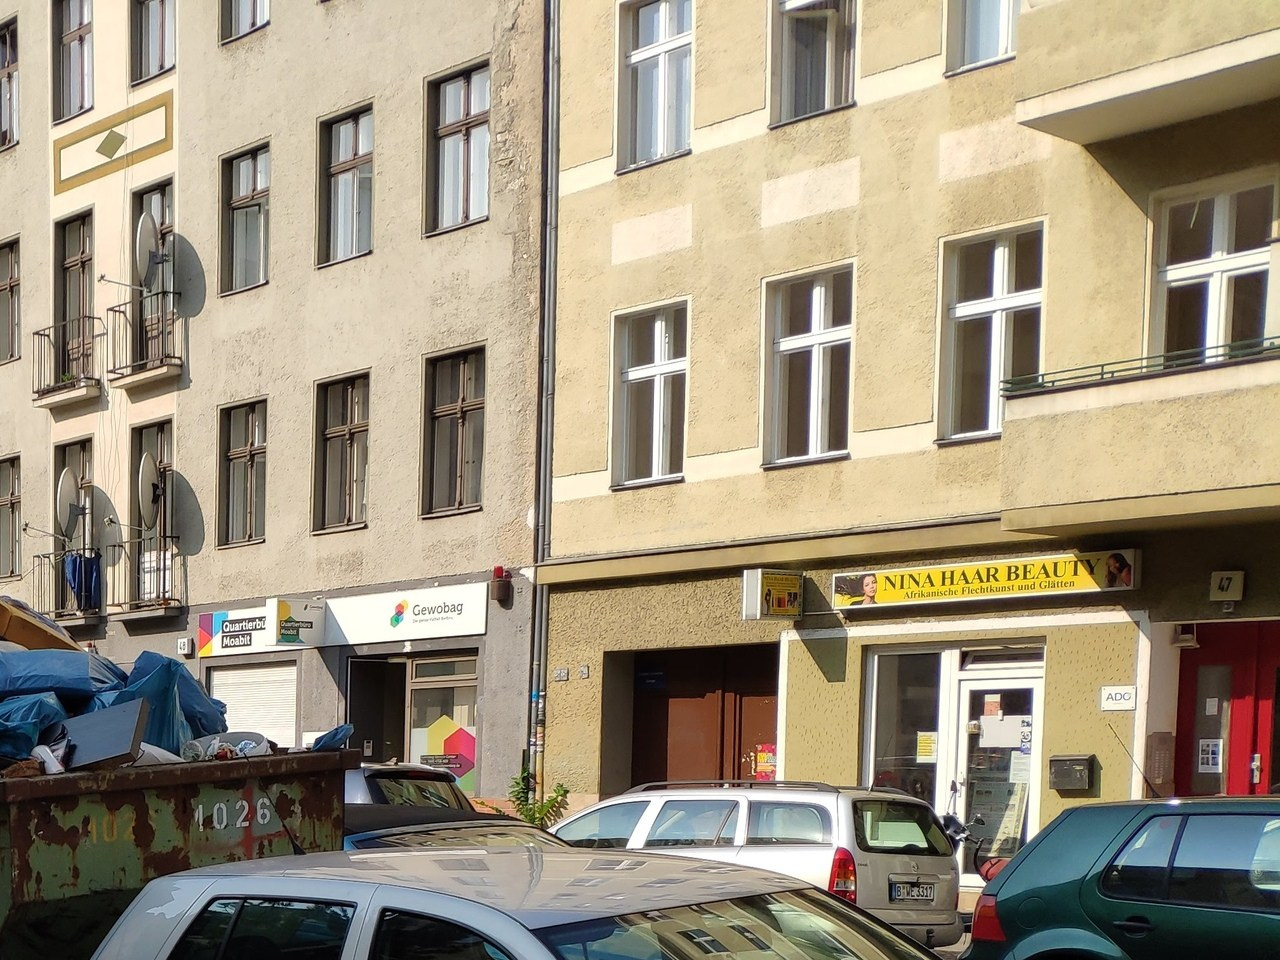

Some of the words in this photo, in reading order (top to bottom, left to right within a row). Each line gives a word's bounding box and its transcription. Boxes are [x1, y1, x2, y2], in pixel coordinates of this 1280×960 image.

[883, 572, 936, 591] NINA
[940, 566, 1000, 587] HAAR
[1006, 558, 1101, 581] BEAUTY
[903, 587, 959, 599] Afrikanische
[961, 583, 1015, 595] Flechtkunst
[1018, 581, 1036, 591] und
[1039, 580, 1075, 590] Glätten
[1217, 576, 1233, 592] 47
[412, 602, 464, 616] Gewobag
[223, 617, 267, 632] Quartierbü
[223, 635, 251, 647] Moabit
[195, 797, 271, 832] 1026
[896, 885, 902, 897] B
[906, 885, 915, 898] WE
